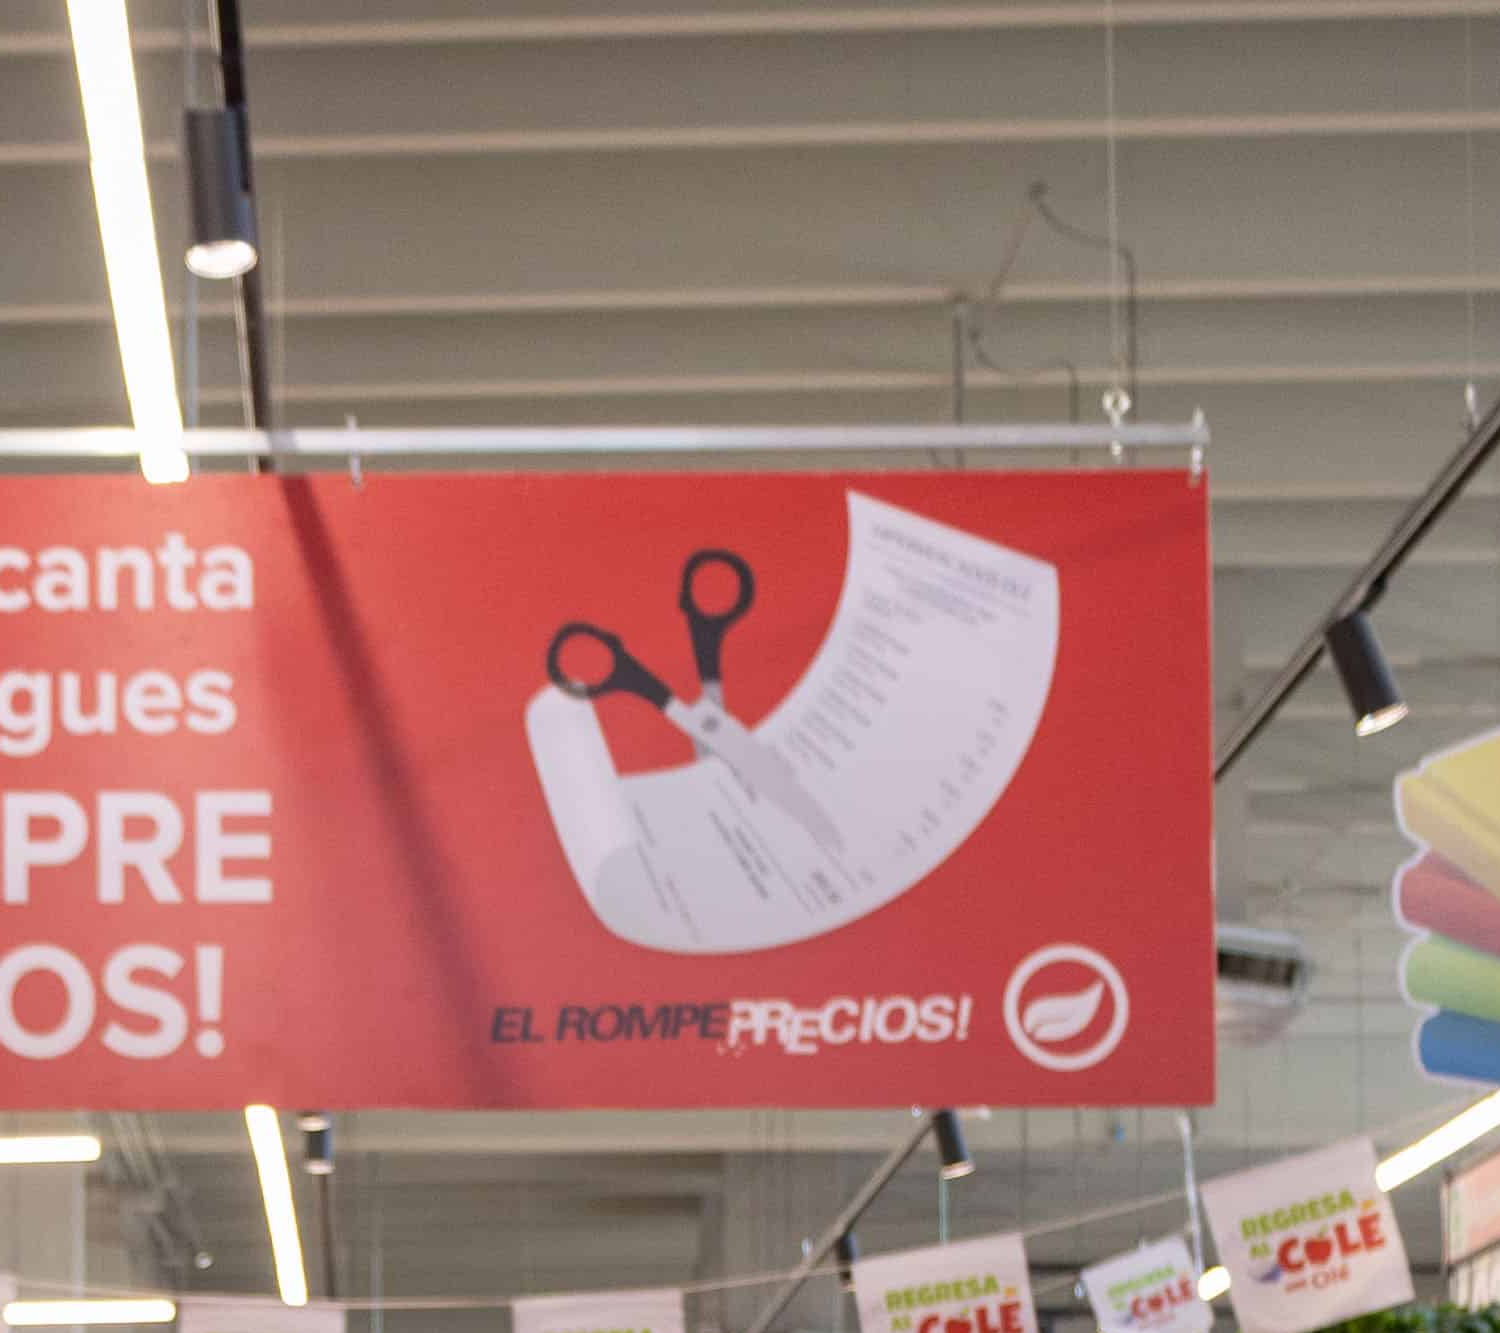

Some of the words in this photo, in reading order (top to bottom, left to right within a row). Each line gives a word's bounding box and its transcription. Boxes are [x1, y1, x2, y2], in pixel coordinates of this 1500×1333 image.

[490, 1007, 545, 1044] EL
[1240, 1188, 1356, 1240] REGRESA
[885, 1274, 1001, 1313] REGRESA
